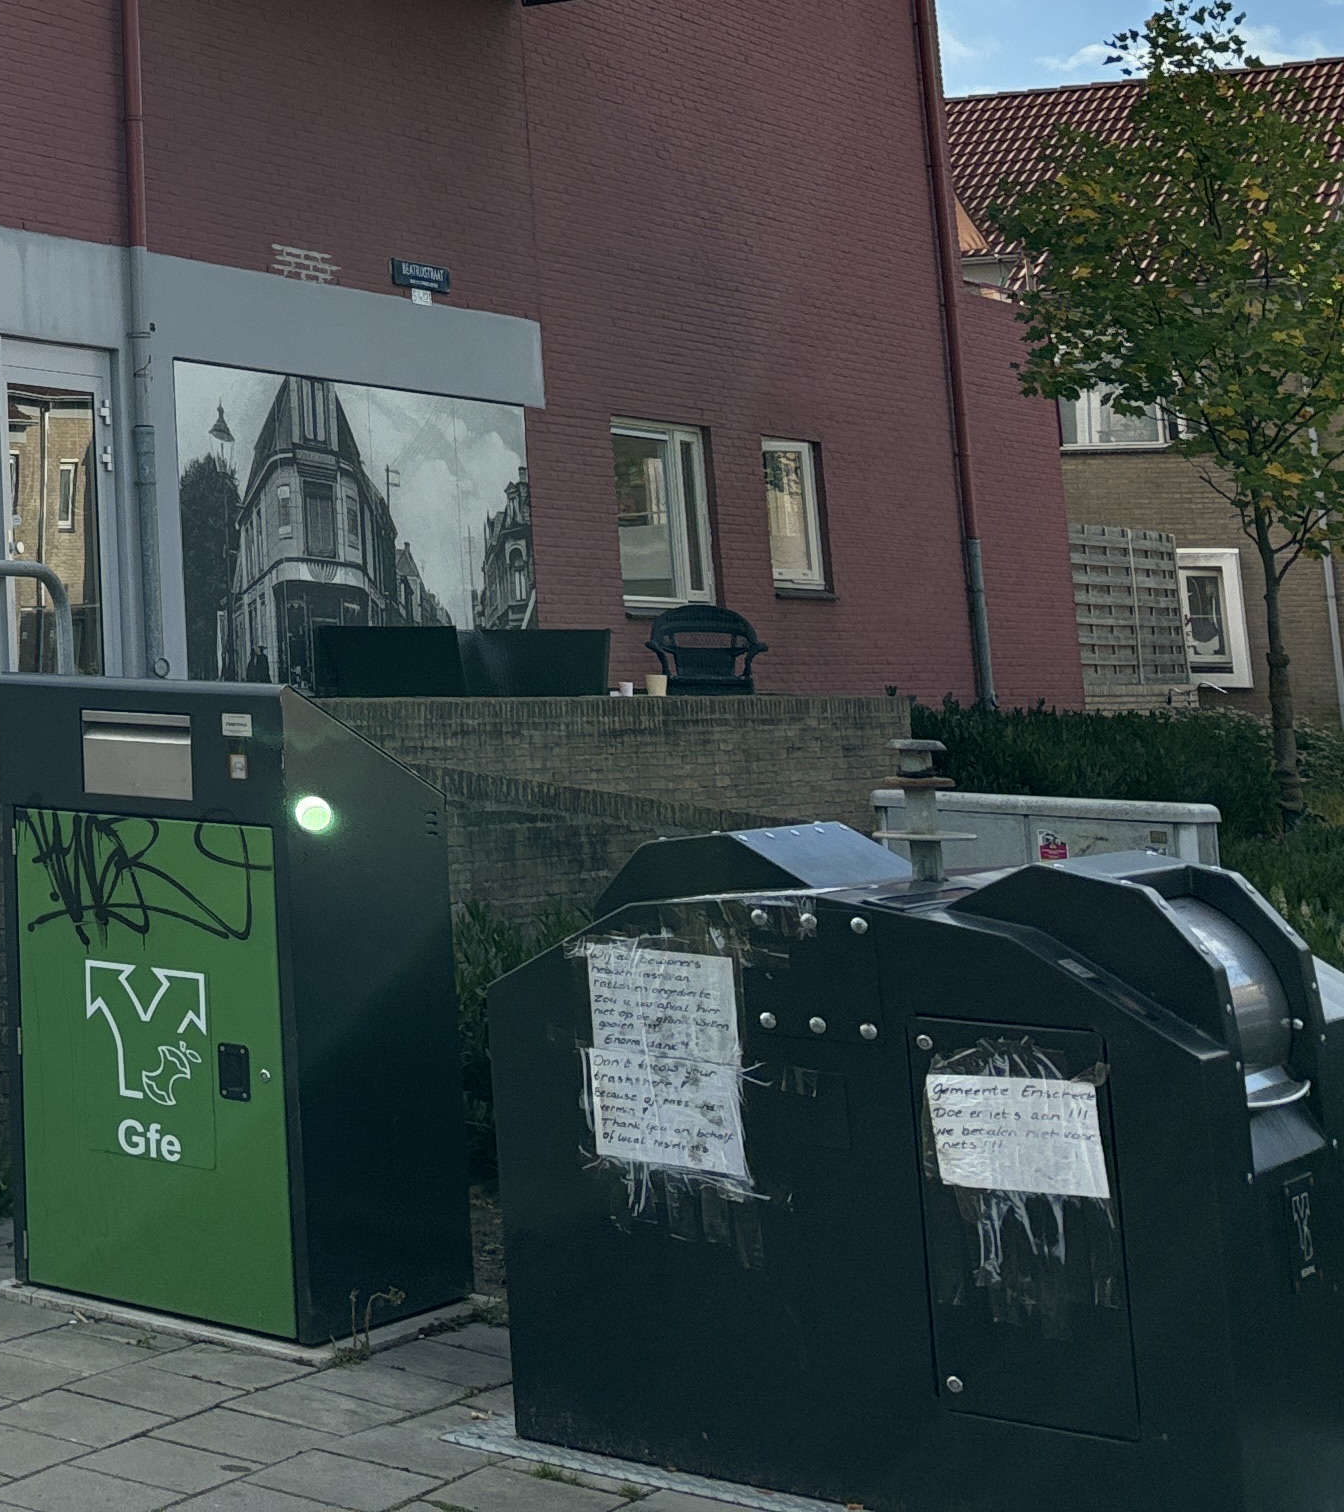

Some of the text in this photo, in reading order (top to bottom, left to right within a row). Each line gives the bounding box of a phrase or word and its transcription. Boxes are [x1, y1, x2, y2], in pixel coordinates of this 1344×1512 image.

[618, 1010, 634, 1020] op
[685, 1066, 717, 1079] your
[933, 1106, 963, 1119] Doe
[969, 1109, 983, 1118] er
[989, 1107, 1022, 1121] iets
[1030, 1112, 1061, 1121] aan
[601, 1117, 640, 1130] Thank
[674, 1127, 691, 1138] on
[696, 1128, 734, 1143] behalf
[961, 1125, 1017, 1138] betalen
[1025, 1129, 1060, 1139] niet
[118, 1118, 181, 1162] Gfe
